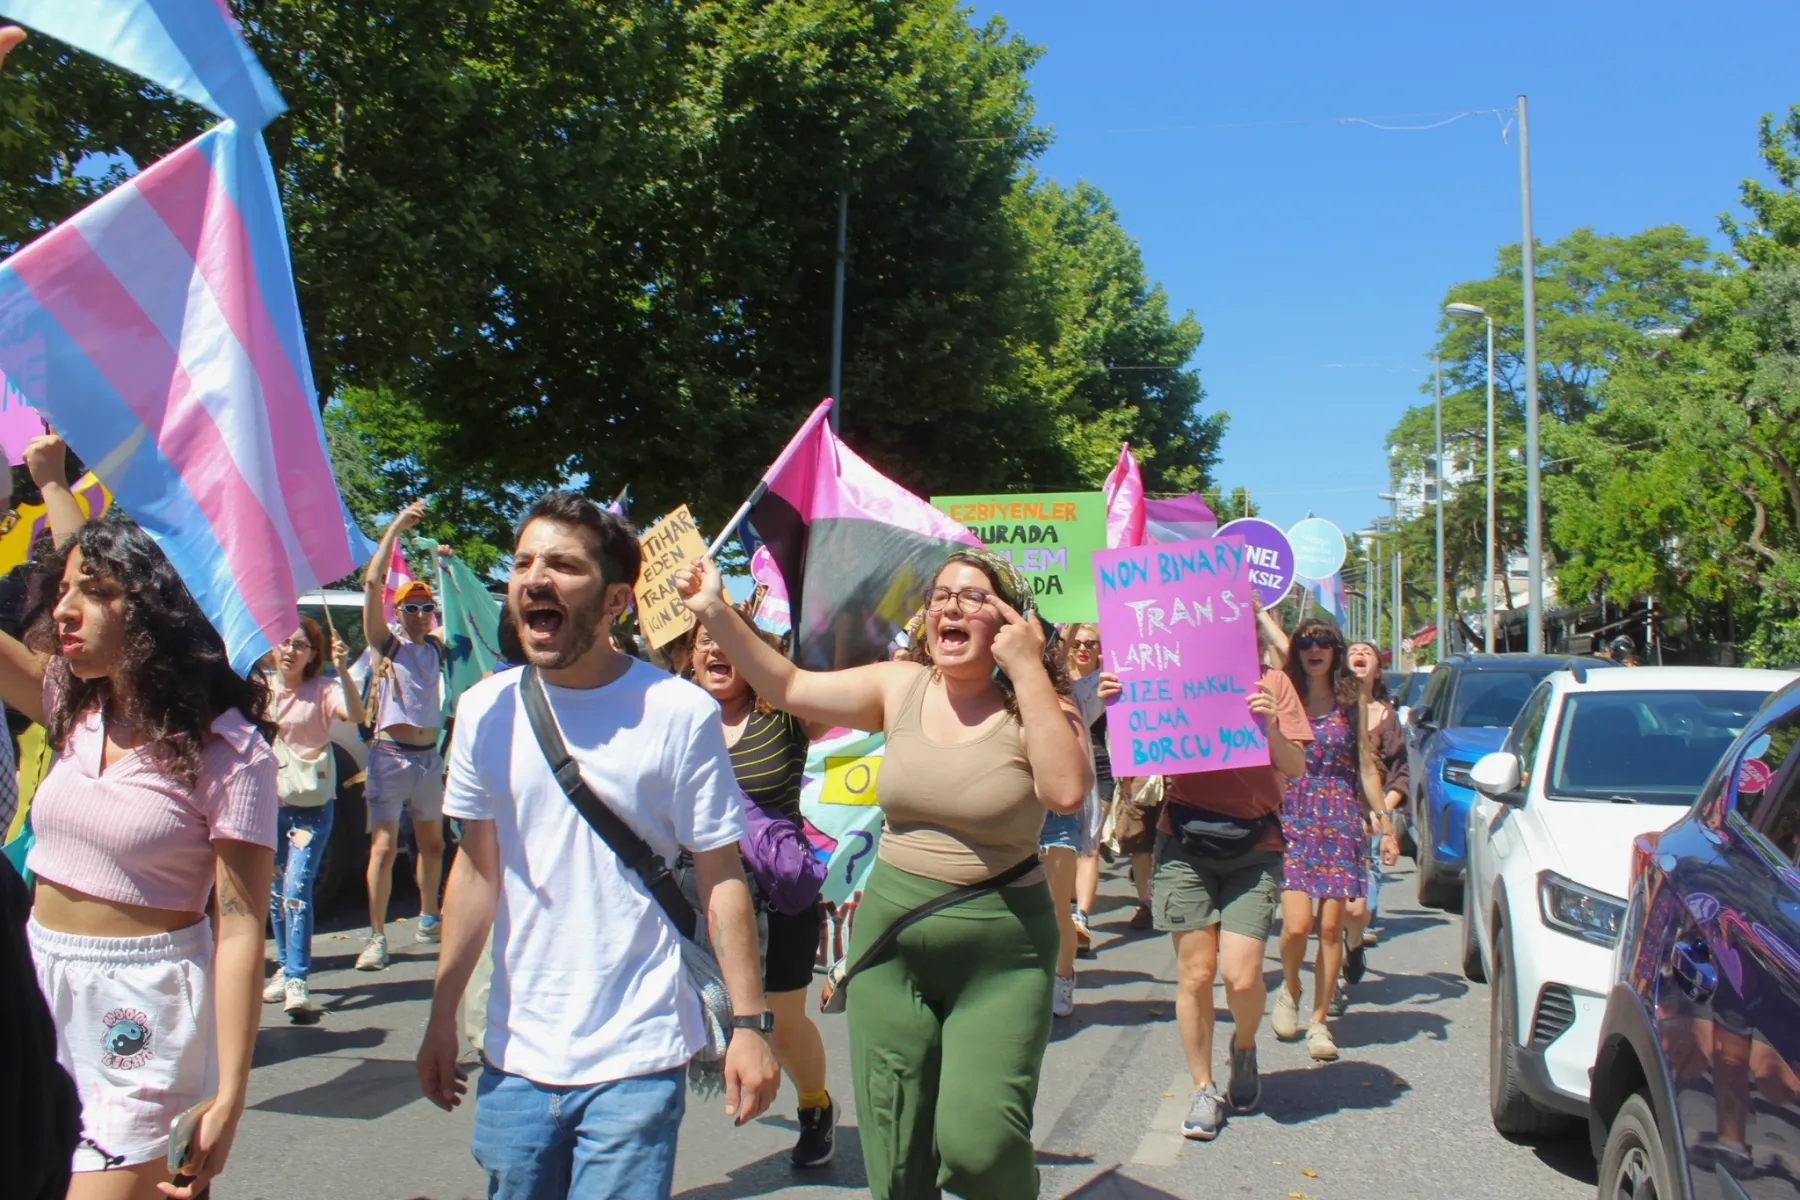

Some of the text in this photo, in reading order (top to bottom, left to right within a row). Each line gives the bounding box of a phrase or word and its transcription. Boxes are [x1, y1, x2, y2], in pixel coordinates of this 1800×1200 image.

[935, 498, 1078, 523] EZBİYENLER
[643, 545, 685, 583] EDEN
[997, 547, 1068, 572] LEM
[1099, 555, 1148, 598] NON
[1157, 539, 1243, 586] BINARY
[1245, 544, 1281, 570] NEL
[639, 574, 677, 609] TRAN
[1248, 569, 1284, 595] KSIZ
[1124, 589, 1250, 638] TRANS-
[1111, 641, 1181, 674] LARIN
[1128, 706, 1190, 732] OLMA
[1131, 734, 1212, 766] BORCU
